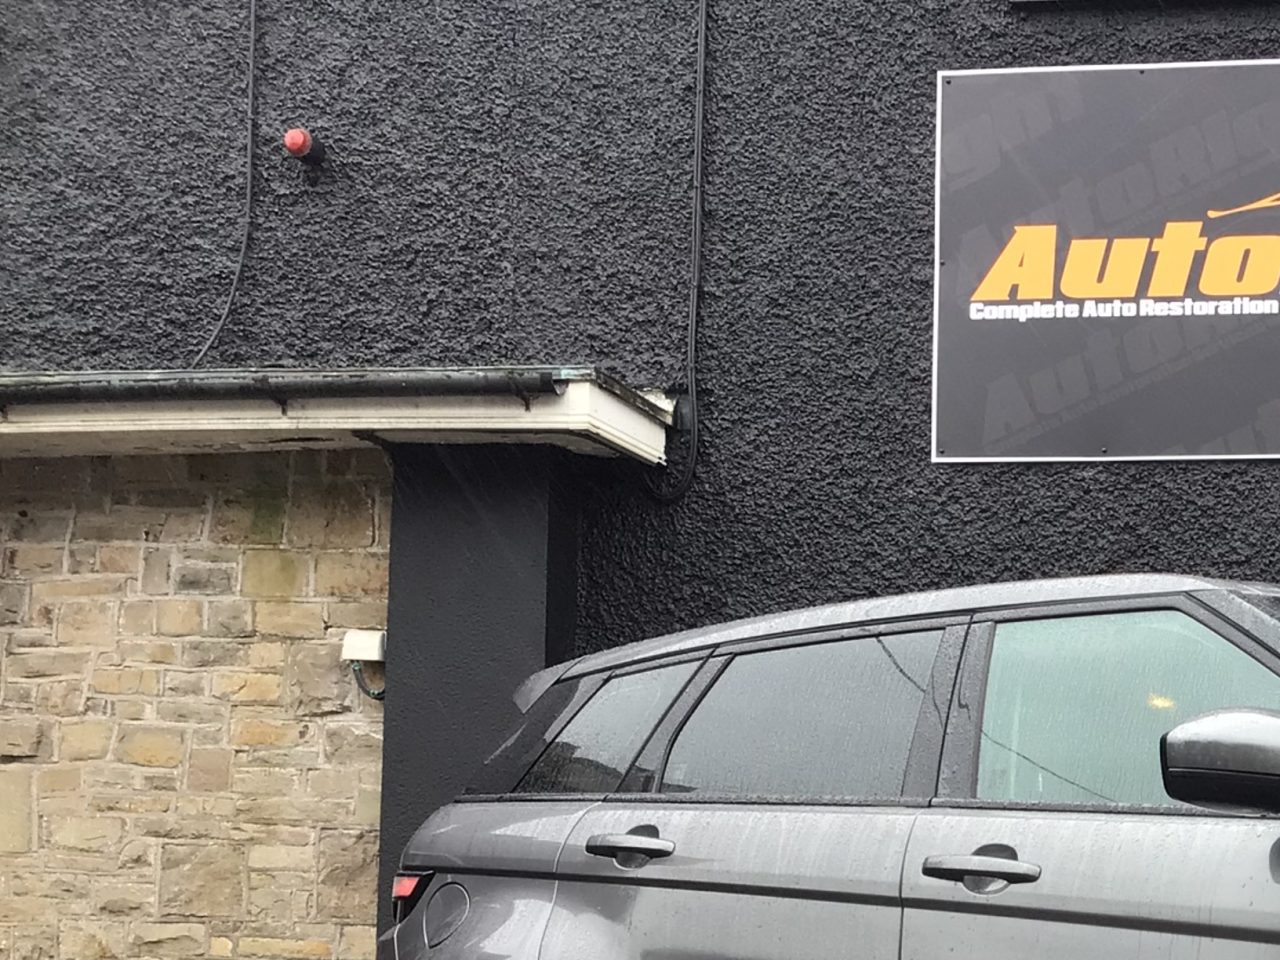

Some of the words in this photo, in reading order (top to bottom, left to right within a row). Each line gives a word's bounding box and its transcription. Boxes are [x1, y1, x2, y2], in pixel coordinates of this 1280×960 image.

[969, 301, 1079, 322] Complete
[1082, 299, 1137, 318] Auto
[1139, 297, 1279, 317] Restoration
